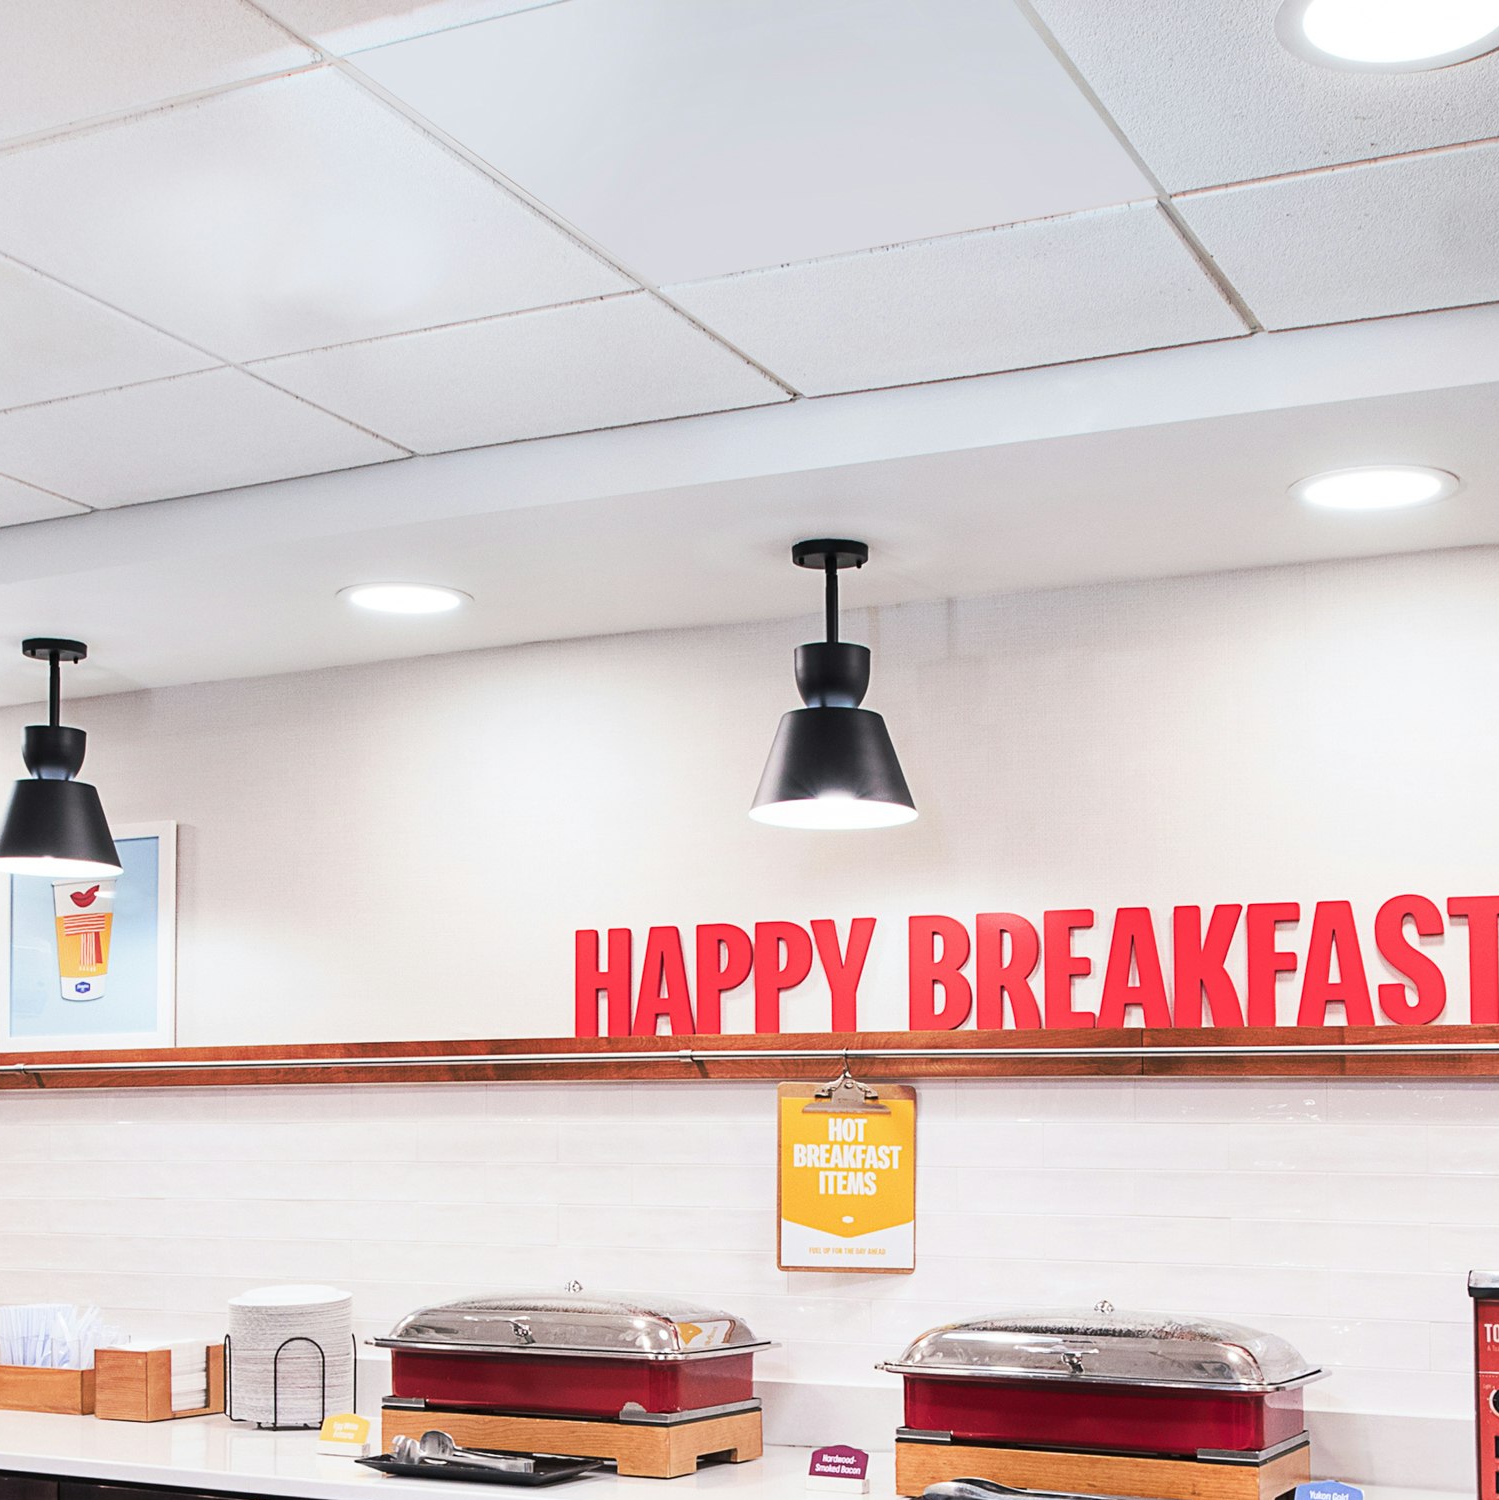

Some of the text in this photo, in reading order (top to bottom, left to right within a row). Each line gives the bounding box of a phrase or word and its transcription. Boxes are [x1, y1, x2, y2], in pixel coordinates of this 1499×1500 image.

[574, 916, 877, 1038] HAPPY
[828, 1118, 867, 1142] HOT
[793, 1144, 902, 1170] BREAKFAST
[818, 1171, 878, 1196] ITEMS
[815, 1463, 861, 1475] Smoked Bacon
[822, 1454, 857, 1464] Hardwood-
[1309, 1490, 1332, 1500] Yukon
